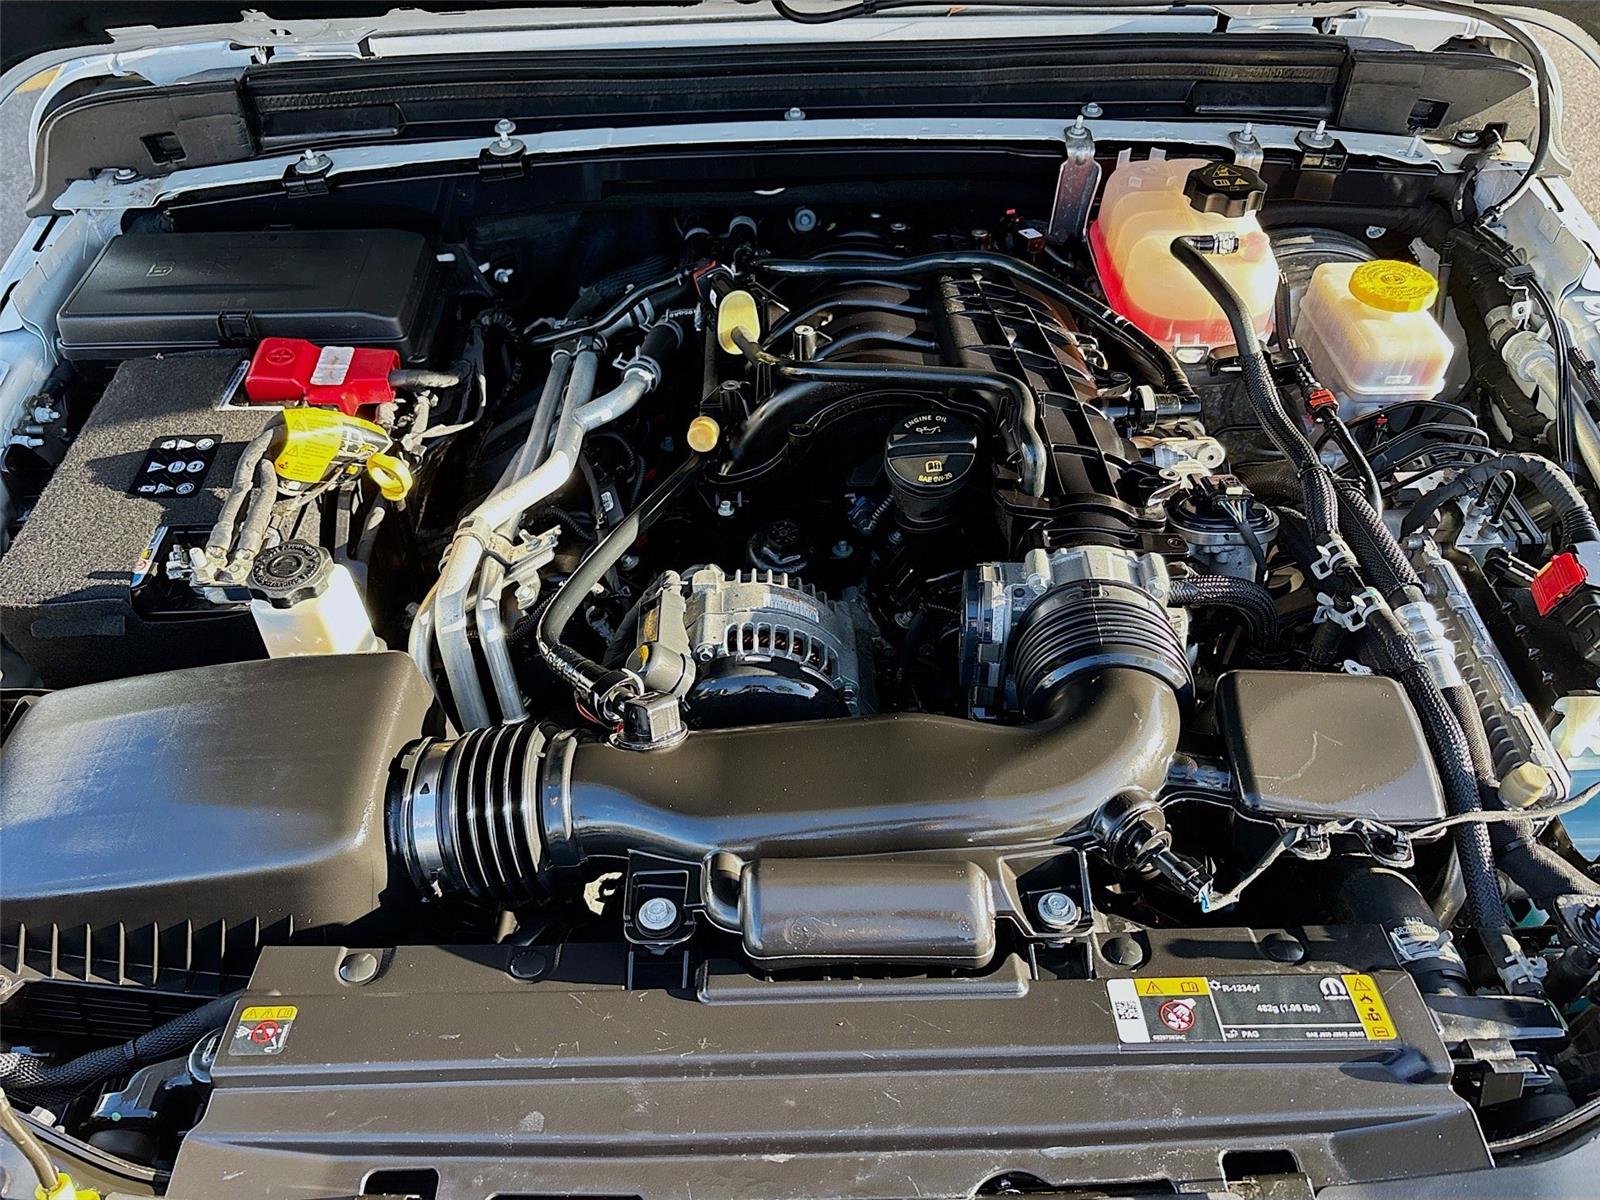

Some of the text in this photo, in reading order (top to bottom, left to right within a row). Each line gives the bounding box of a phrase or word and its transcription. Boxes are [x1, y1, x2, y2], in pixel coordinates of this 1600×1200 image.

[904, 415, 948, 429] ENGINE OIL
[918, 472, 953, 483] SAE 0W-20
[1221, 983, 1261, 994] R-1234yf
[1241, 1030, 1260, 1038] PAG
